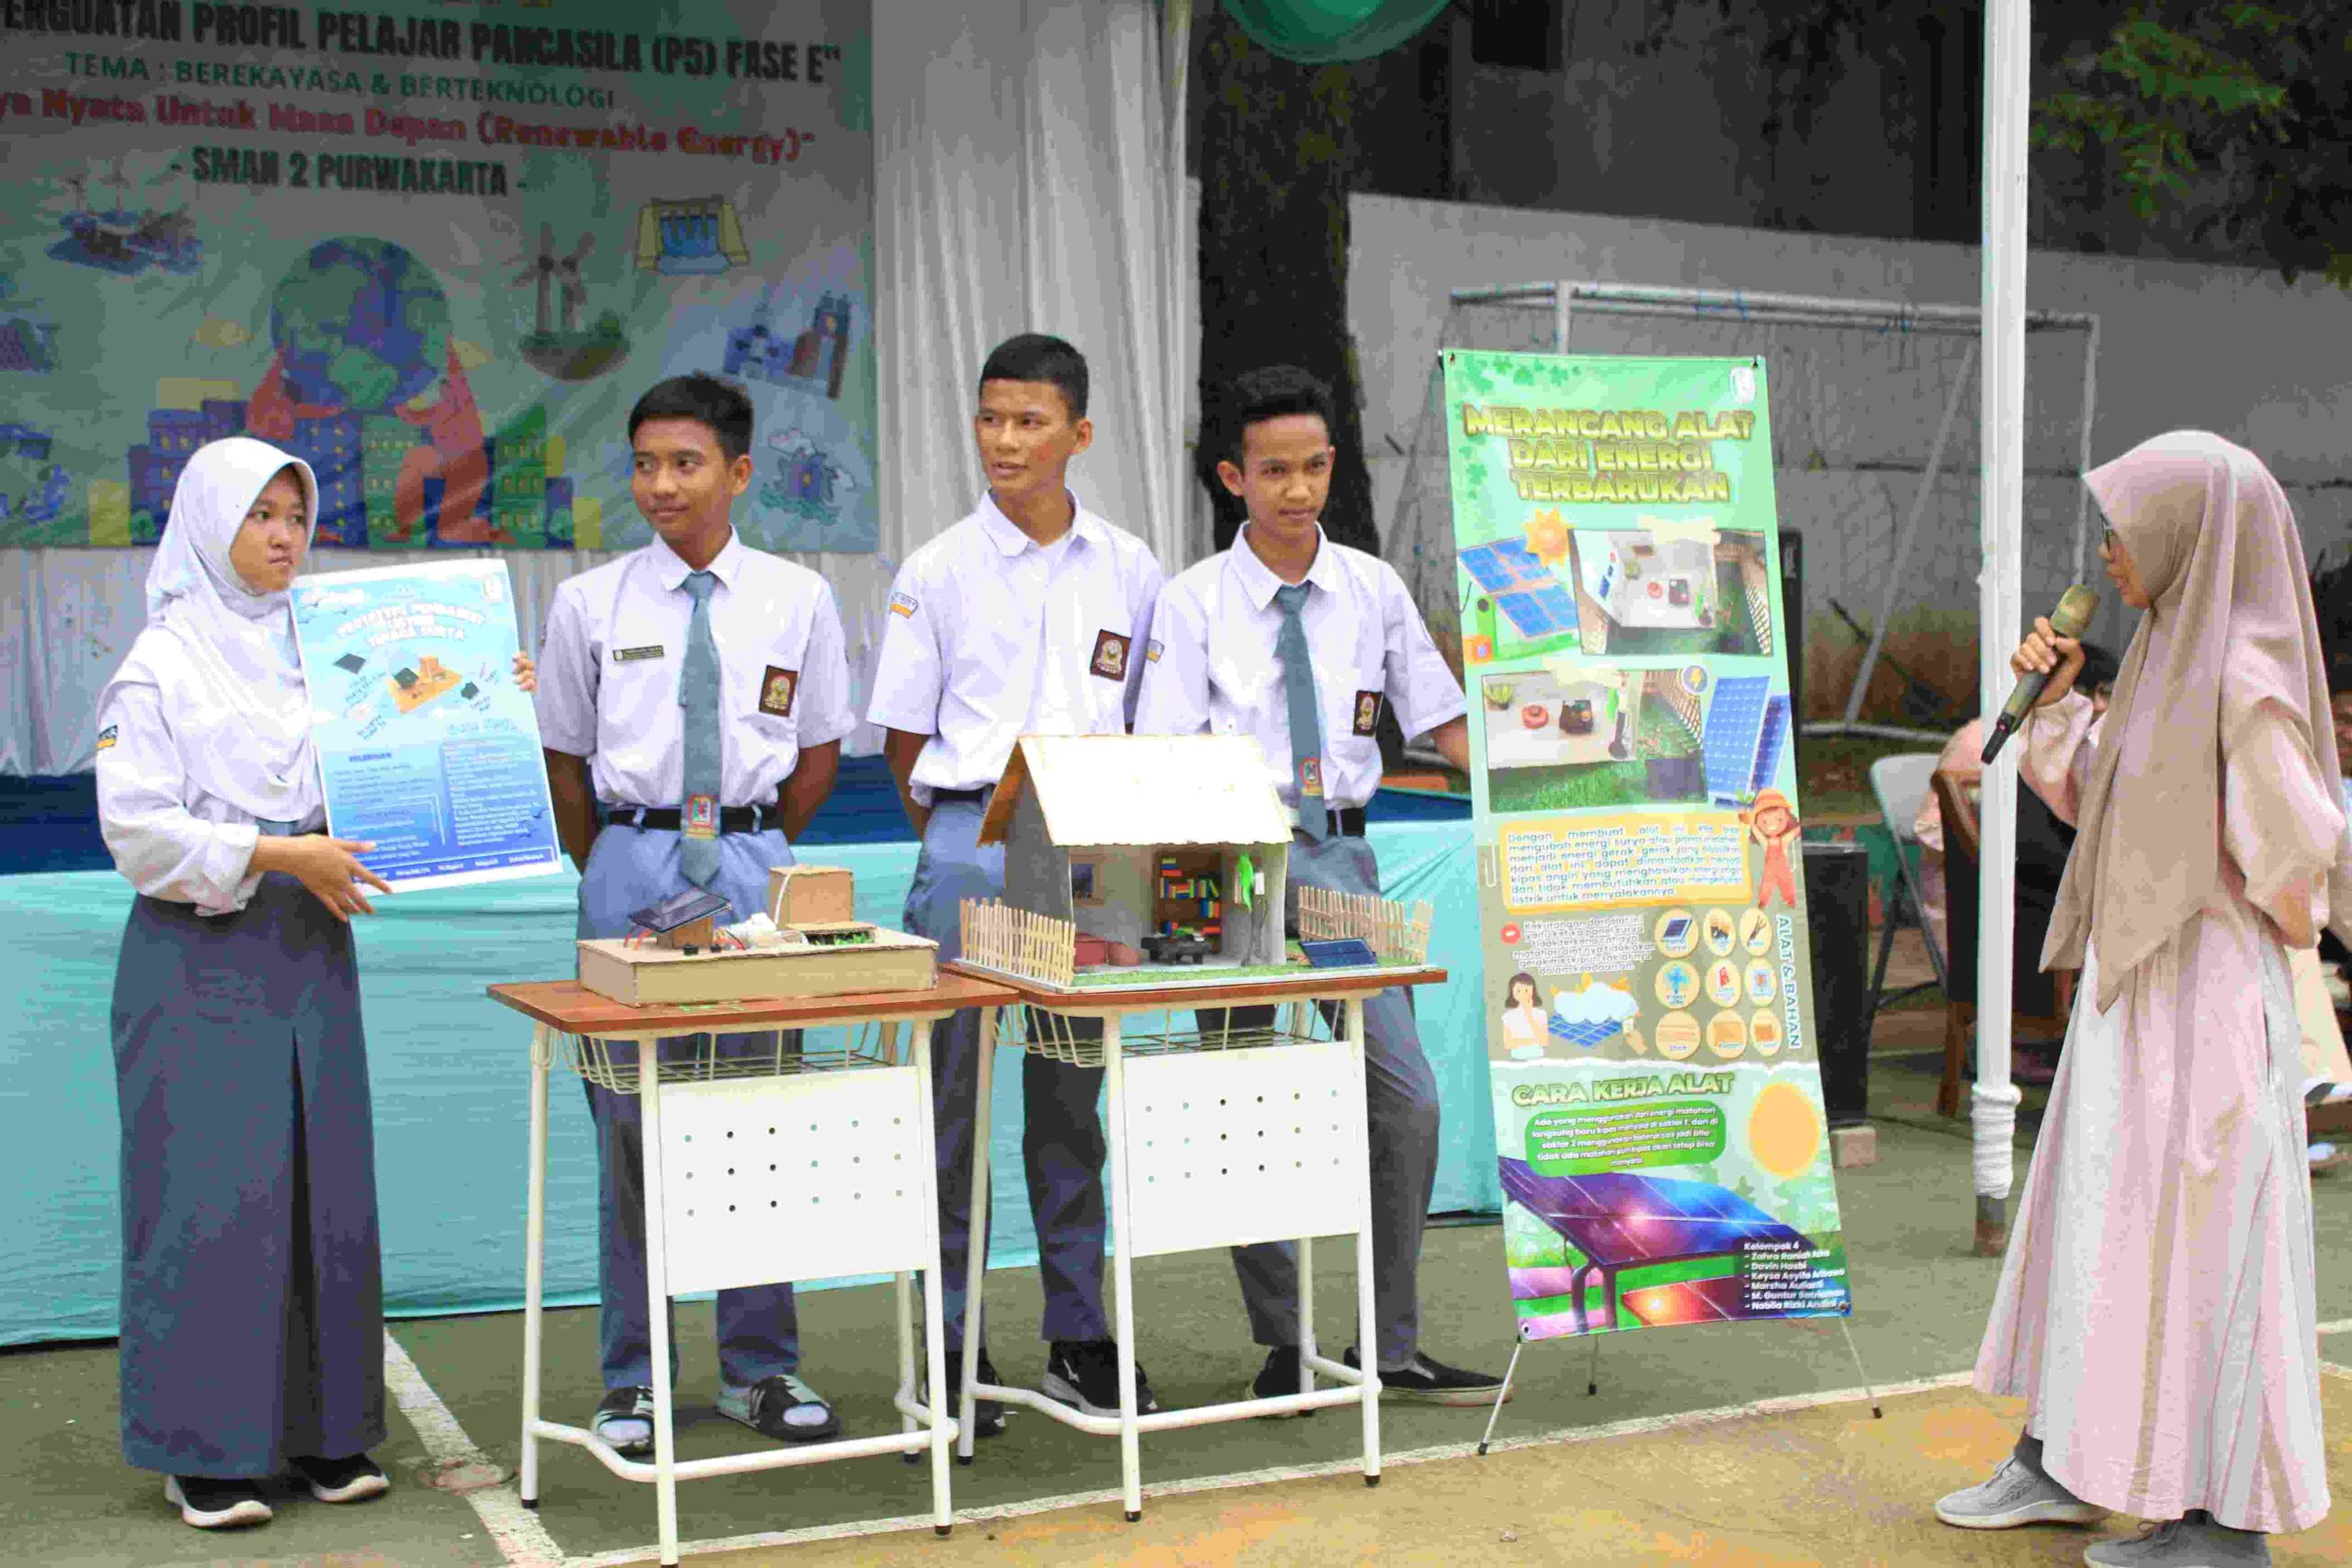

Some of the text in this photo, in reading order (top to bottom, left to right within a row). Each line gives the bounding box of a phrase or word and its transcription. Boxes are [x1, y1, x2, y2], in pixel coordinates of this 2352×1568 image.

[193, 2, 307, 49] PROFIL
[318, 11, 461, 60] PELAJAR
[470, 23, 642, 73] PANCASILA
[653, 35, 718, 76] (P5)
[727, 39, 799, 81] FASE
[65, 51, 150, 80] TEMA
[175, 60, 362, 95] BEREKAYASA
[372, 73, 393, 95] &
[401, 73, 614, 108] BERTEKNOLOGI
[42, 87, 145, 126] Nyata
[157, 94, 256, 130] Untuk
[193, 145, 279, 186] SMAN
[288, 150, 312, 188] 2
[317, 152, 509, 197] PURWAKARTA
[1462, 403, 1756, 442] MERANCANG ALAT
[1508, 436, 1714, 472] DARI ENERGI
[1510, 468, 1731, 504] TERBARUKAN
[1509, 833, 1552, 842] Dengan
[1567, 829, 1623, 840] membuat
[1510, 841, 1572, 852] mengubah
[1575, 839, 1611, 851] energi
[1614, 837, 1646, 847] surya
[1510, 852, 1557, 864] menjadi
[1561, 848, 1597, 861] energi
[1595, 856, 1631, 869] dapat
[1545, 871, 1578, 882] angin
[1582, 869, 1611, 880] yang
[1784, 981, 1802, 1048] BAHAN
[1511, 1071, 1736, 1107] CARA KERJA ALAT
[1752, 1252, 1780, 1260] Zahra
[1792, 1241, 1799, 1249] 4
[1752, 1262, 1779, 1270] Davin
